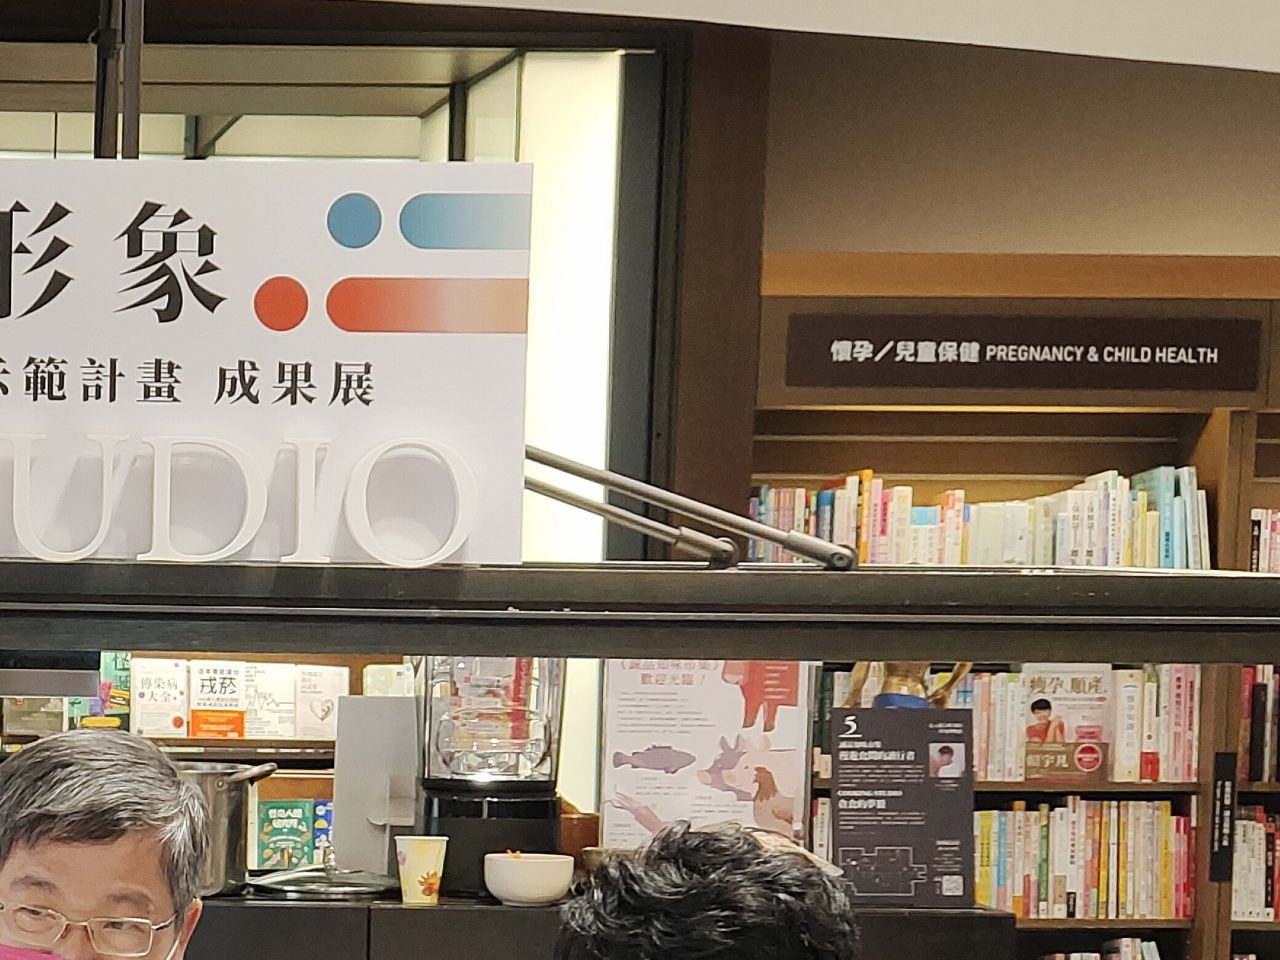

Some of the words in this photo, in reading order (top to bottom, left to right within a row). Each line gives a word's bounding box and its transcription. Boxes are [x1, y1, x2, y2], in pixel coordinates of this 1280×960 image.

[985, 345, 1084, 362] PREGNANCY
[1087, 347, 1099, 363] &
[1103, 347, 1152, 363] CHILD
[1154, 347, 1219, 364] HEALTH
[213, 361, 376, 407] 成果展
[843, 715, 857, 735] 5
